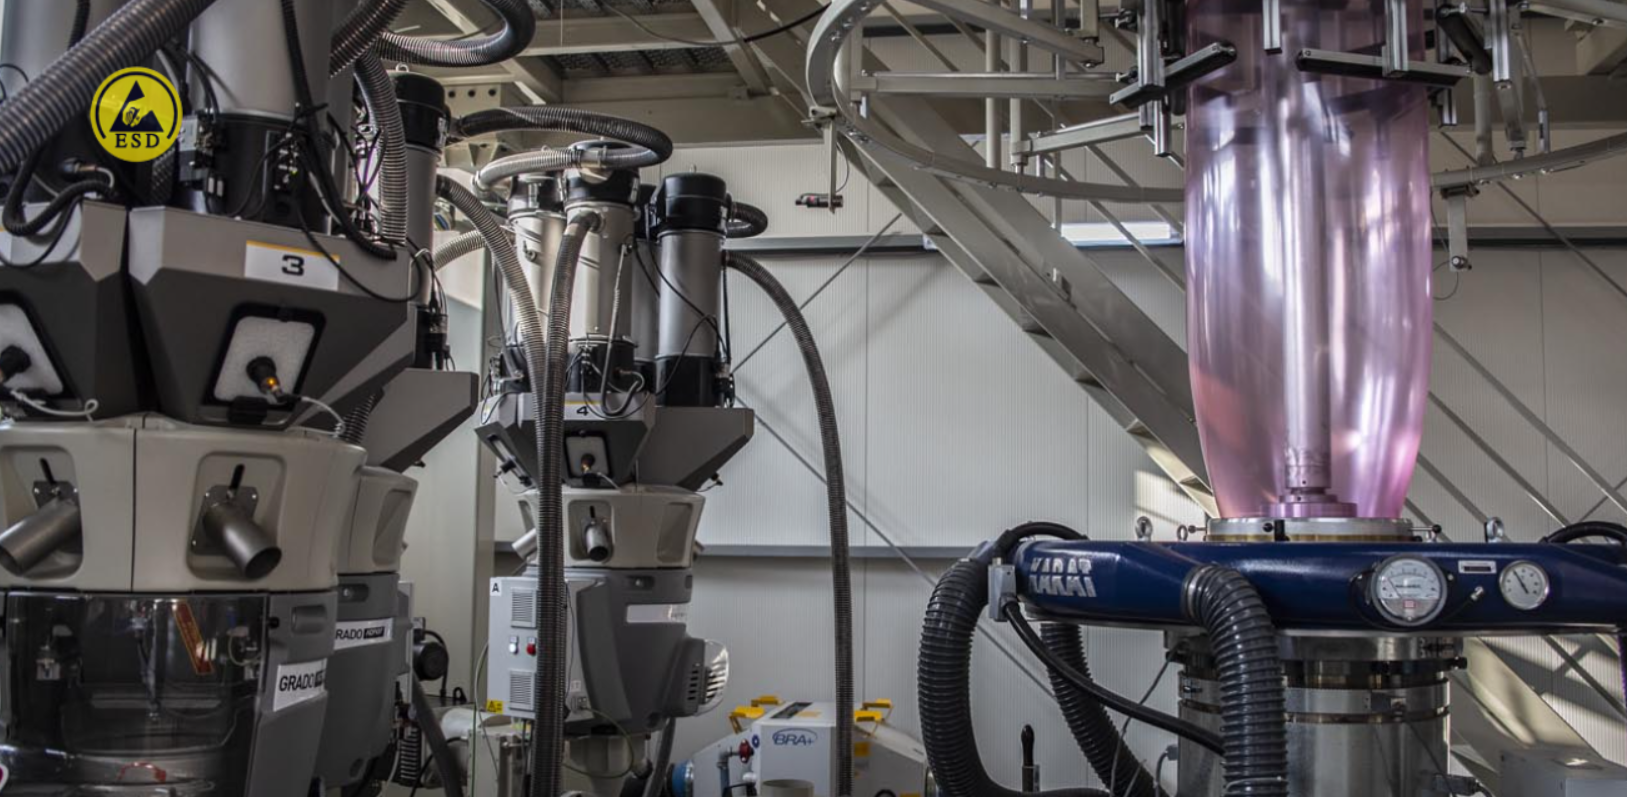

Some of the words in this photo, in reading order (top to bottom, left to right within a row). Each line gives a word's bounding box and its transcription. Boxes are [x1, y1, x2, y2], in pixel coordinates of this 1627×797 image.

[281, 254, 304, 276] 3
[576, 405, 589, 417] 4
[1029, 557, 1097, 598] KARAT
[492, 583, 500, 593] A
[335, 628, 363, 640] RADO
[279, 673, 314, 691] GRADO
